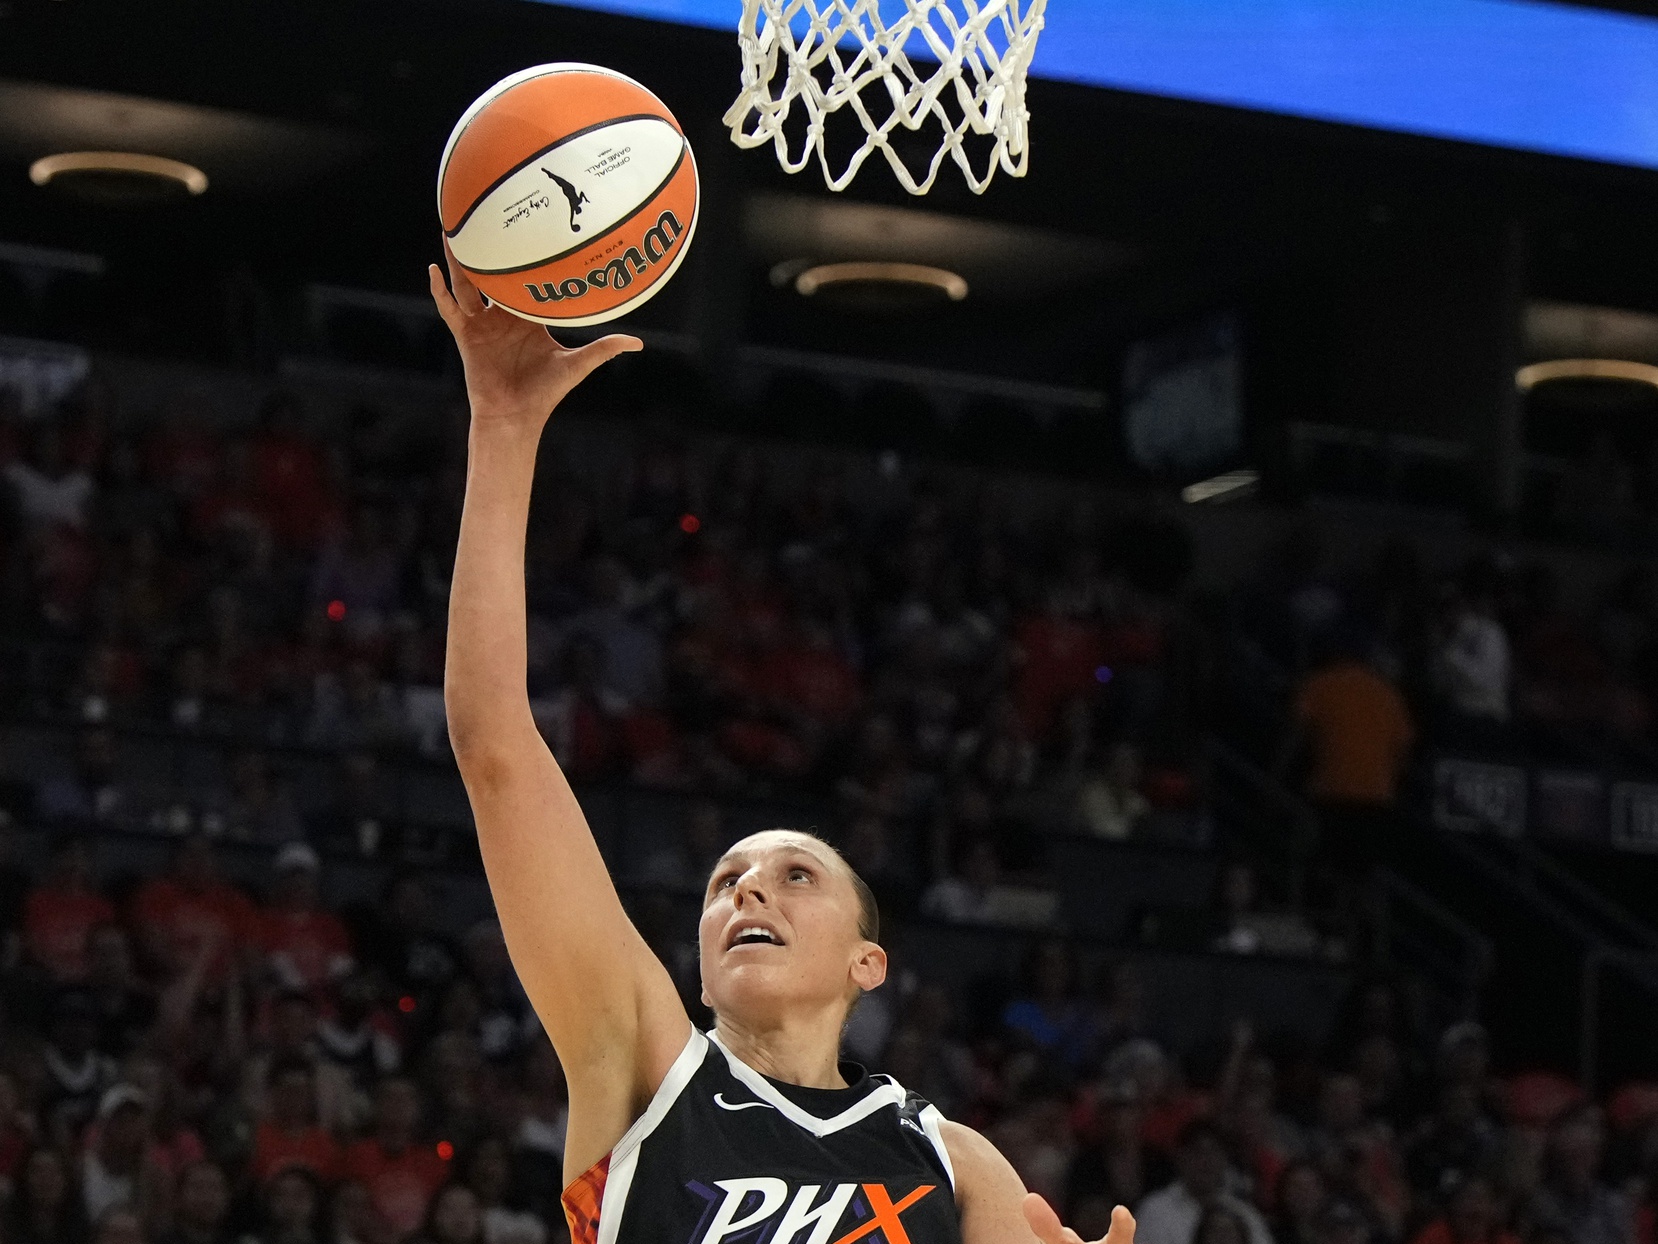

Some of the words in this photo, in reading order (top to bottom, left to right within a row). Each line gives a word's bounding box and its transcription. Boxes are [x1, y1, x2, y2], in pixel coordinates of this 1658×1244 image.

[607, 146, 631, 162] GAME
[584, 159, 607, 173] BALL
[594, 156, 631, 178] OFFICIAL
[523, 209, 684, 303] Wilson
[583, 253, 603, 266] NXT
